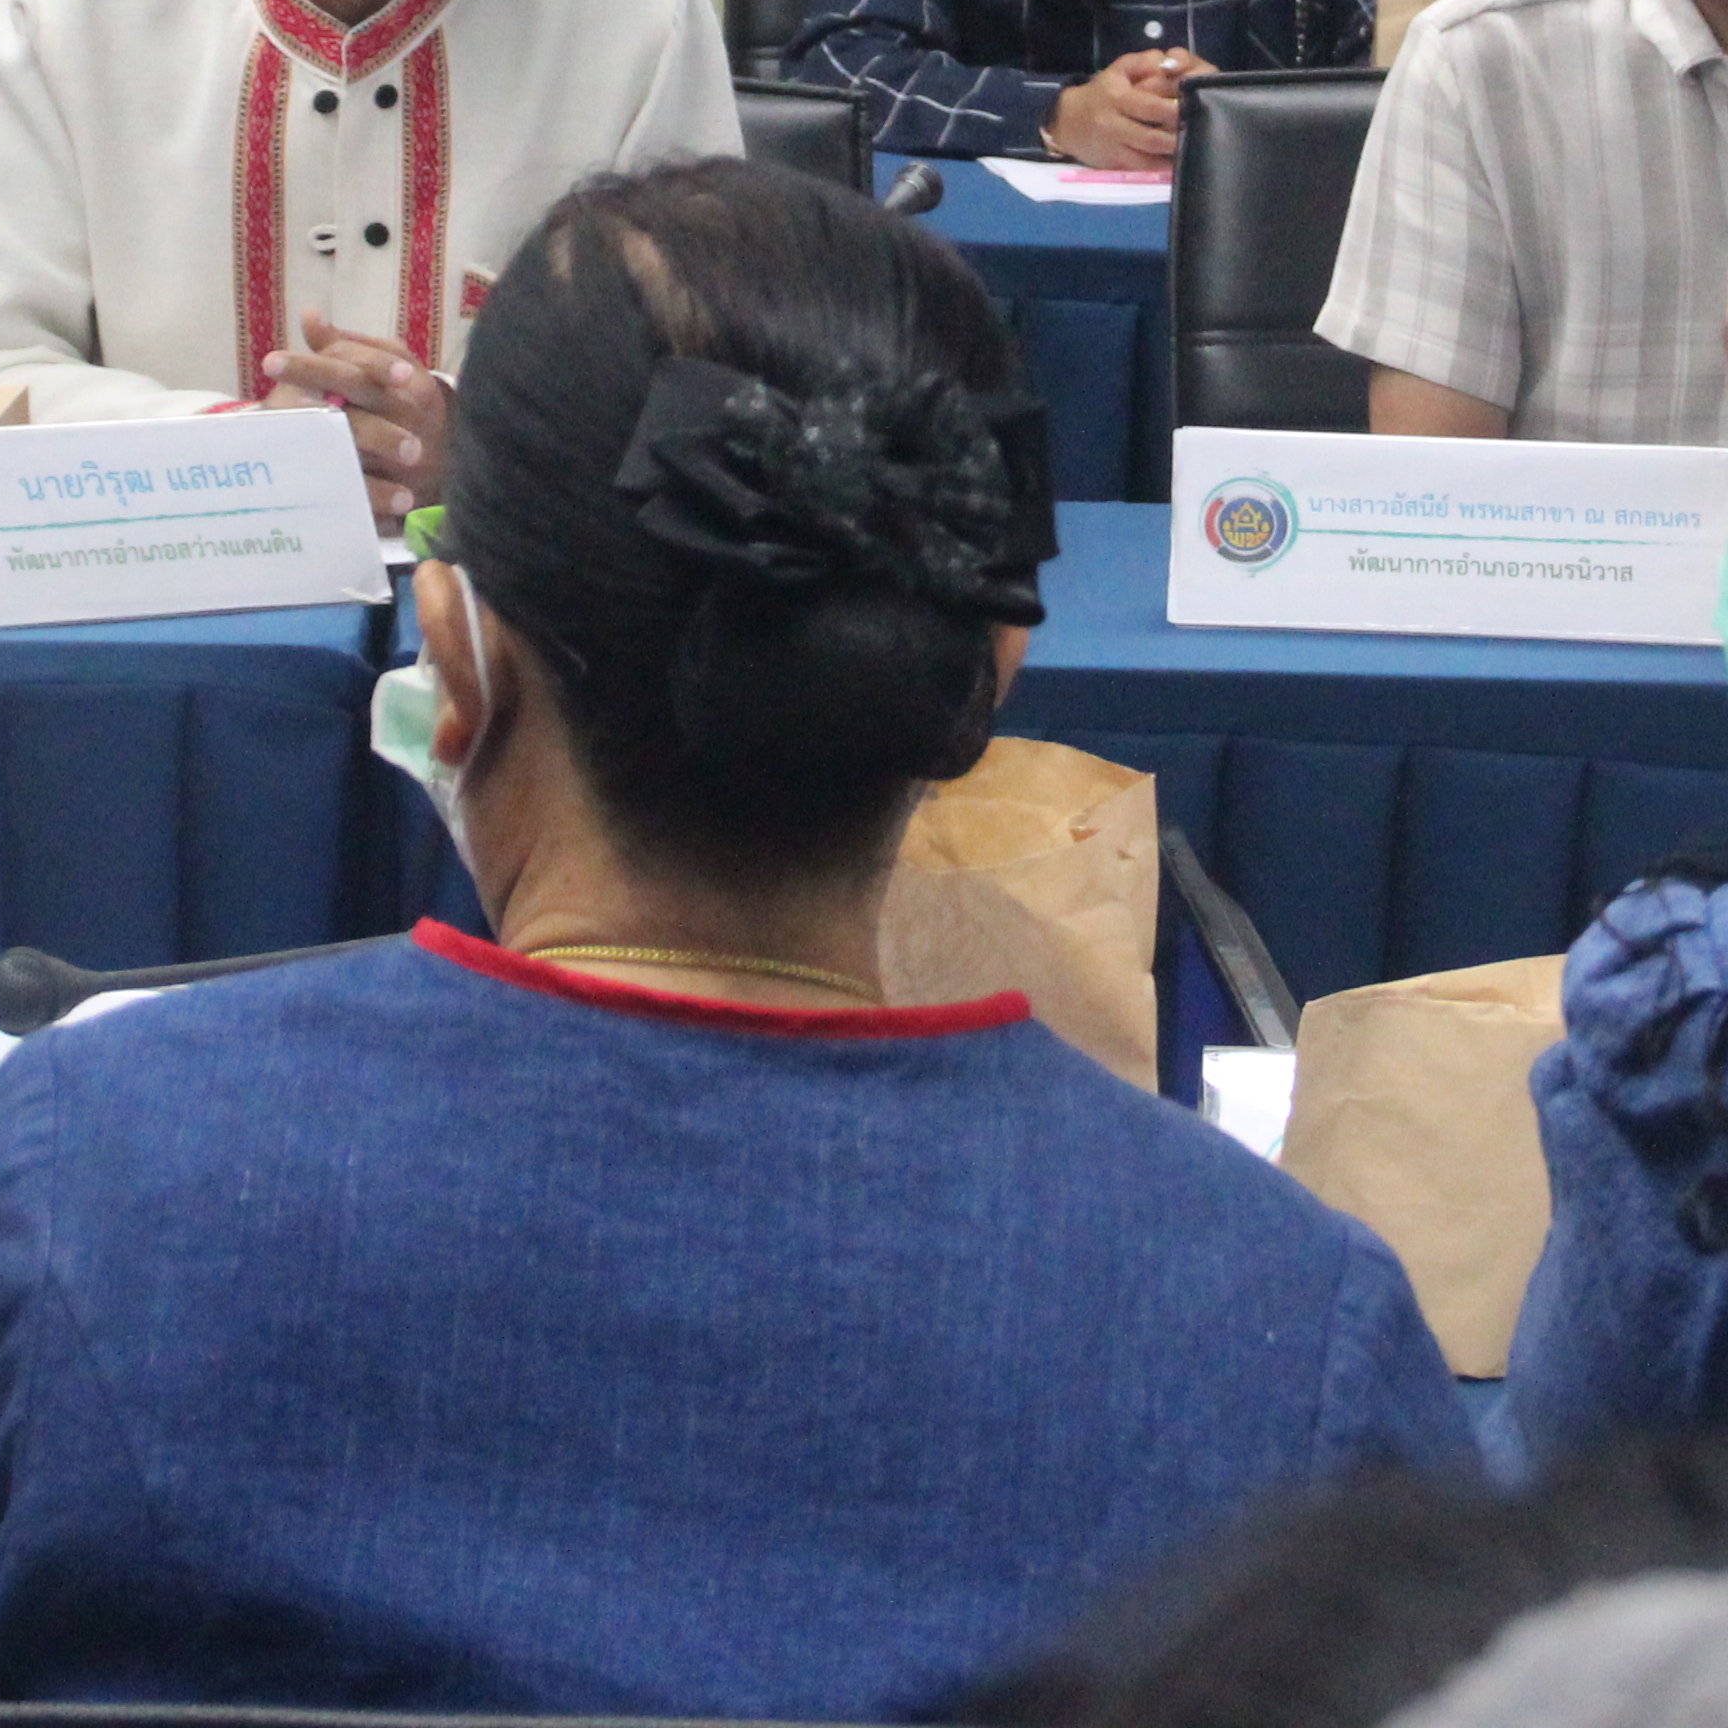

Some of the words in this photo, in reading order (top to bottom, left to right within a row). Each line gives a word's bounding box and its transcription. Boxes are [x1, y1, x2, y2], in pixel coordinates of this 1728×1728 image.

[167, 460, 273, 493] แสนสา
[1458, 499, 1576, 526] พรหมสาขา
[1585, 505, 1605, 525] ณ
[1614, 504, 1702, 530] สกลนคร
[6, 527, 303, 574] พัฒนาการอำเภอสว่างแดนดิน
[1348, 548, 1635, 584] พัฒนาการอำเภอวานรนิวาส
